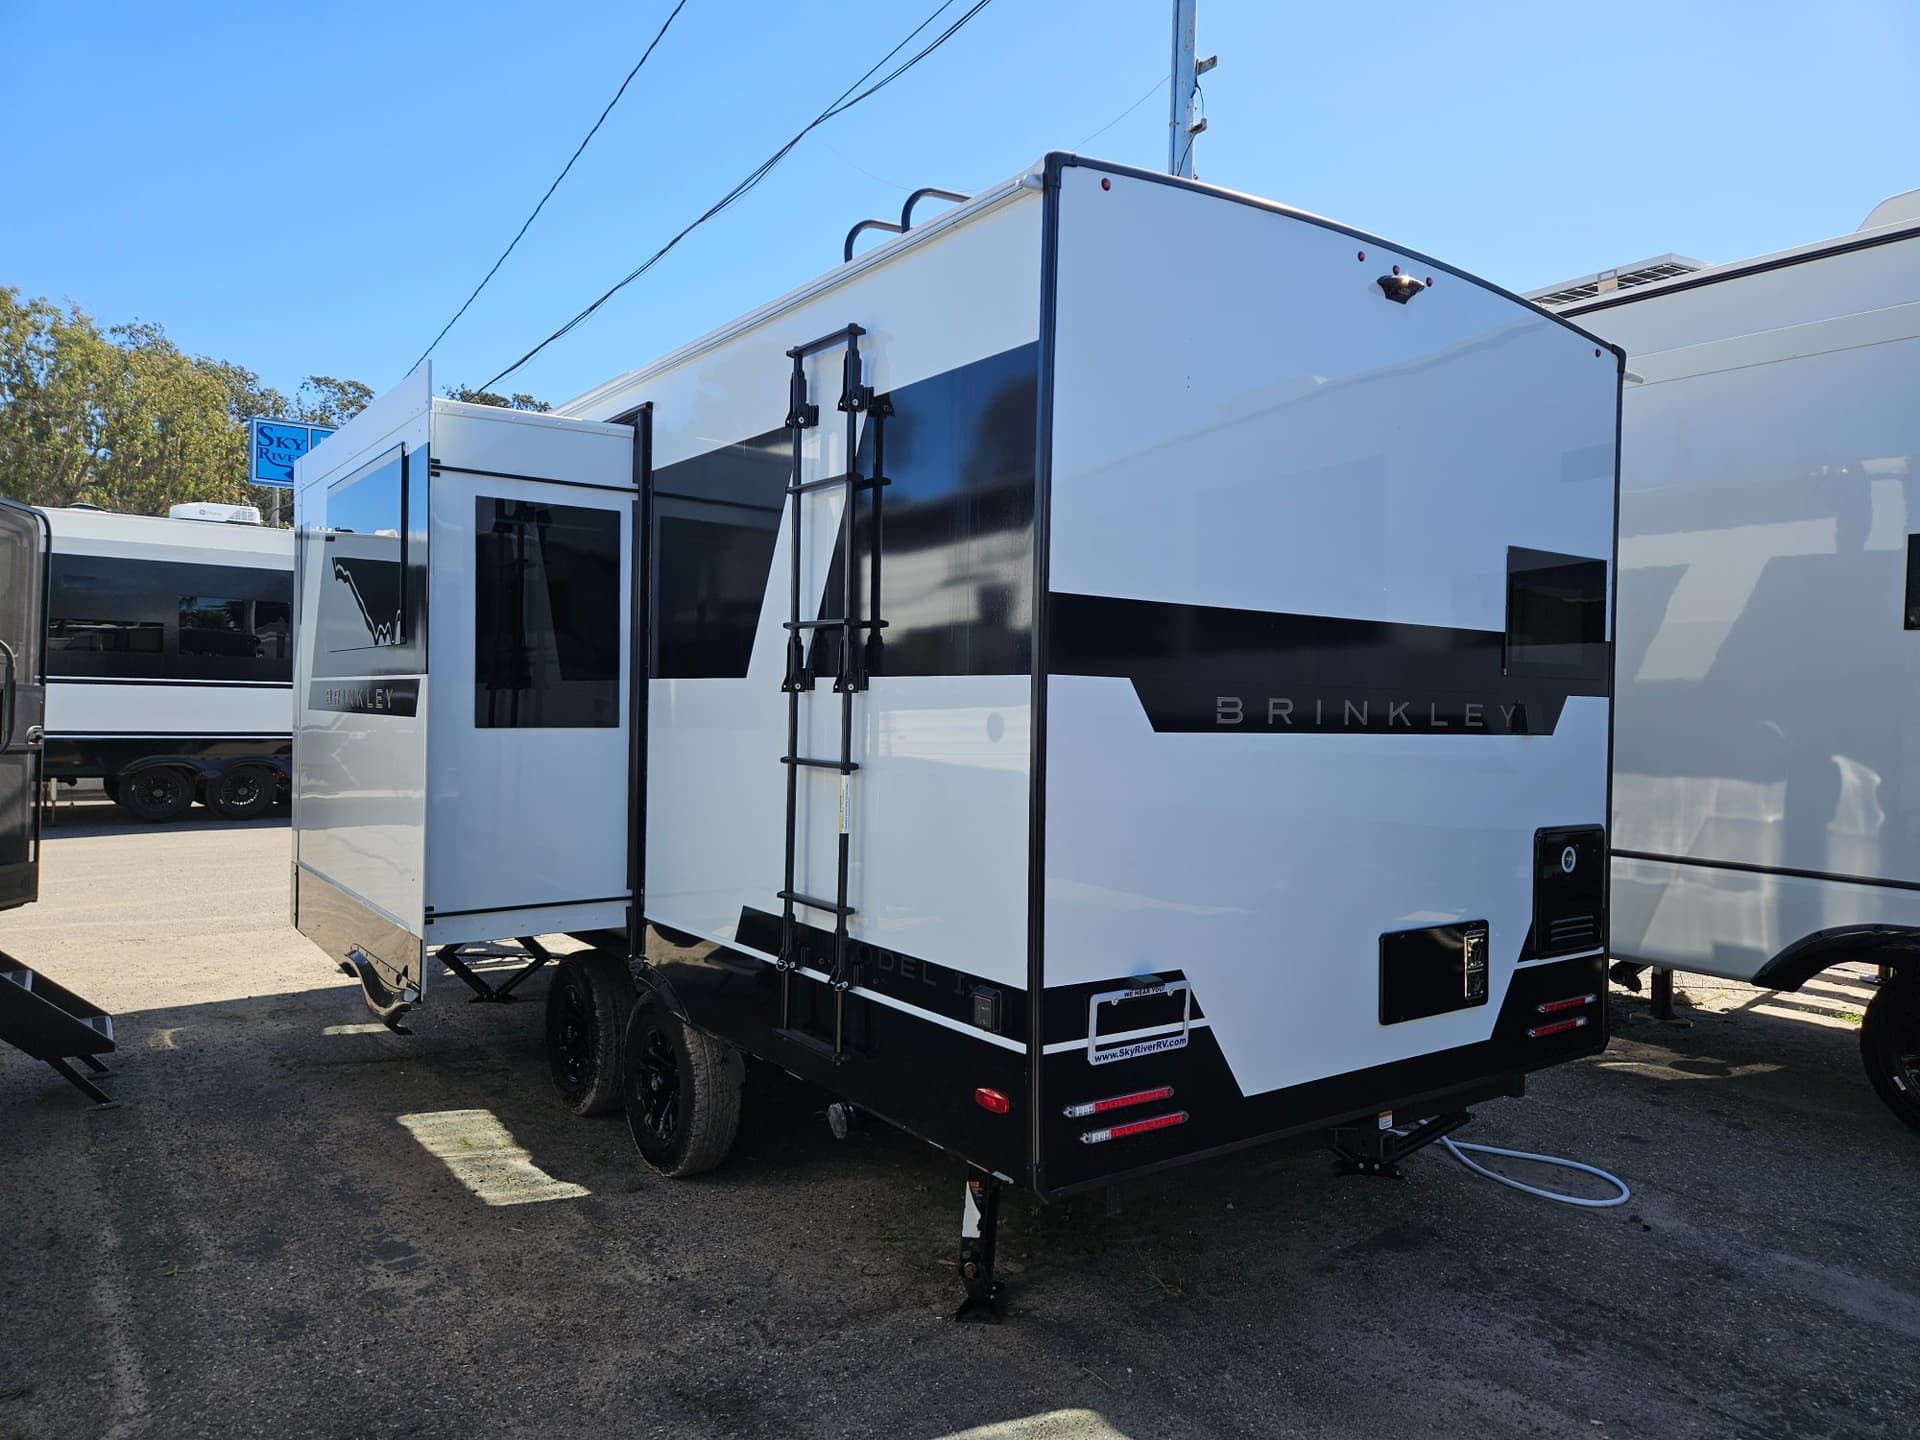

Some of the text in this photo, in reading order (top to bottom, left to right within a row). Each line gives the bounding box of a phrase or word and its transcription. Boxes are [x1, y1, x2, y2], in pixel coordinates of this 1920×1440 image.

[258, 426, 305, 451] SKY
[258, 447, 301, 466] RIVE
[325, 688, 394, 709] BRINKLEY
[1216, 696, 1517, 728] BRINKLEY
[855, 943, 937, 986] ODEL
[1094, 1037, 1187, 1063] www.SkyRiverRV.com
